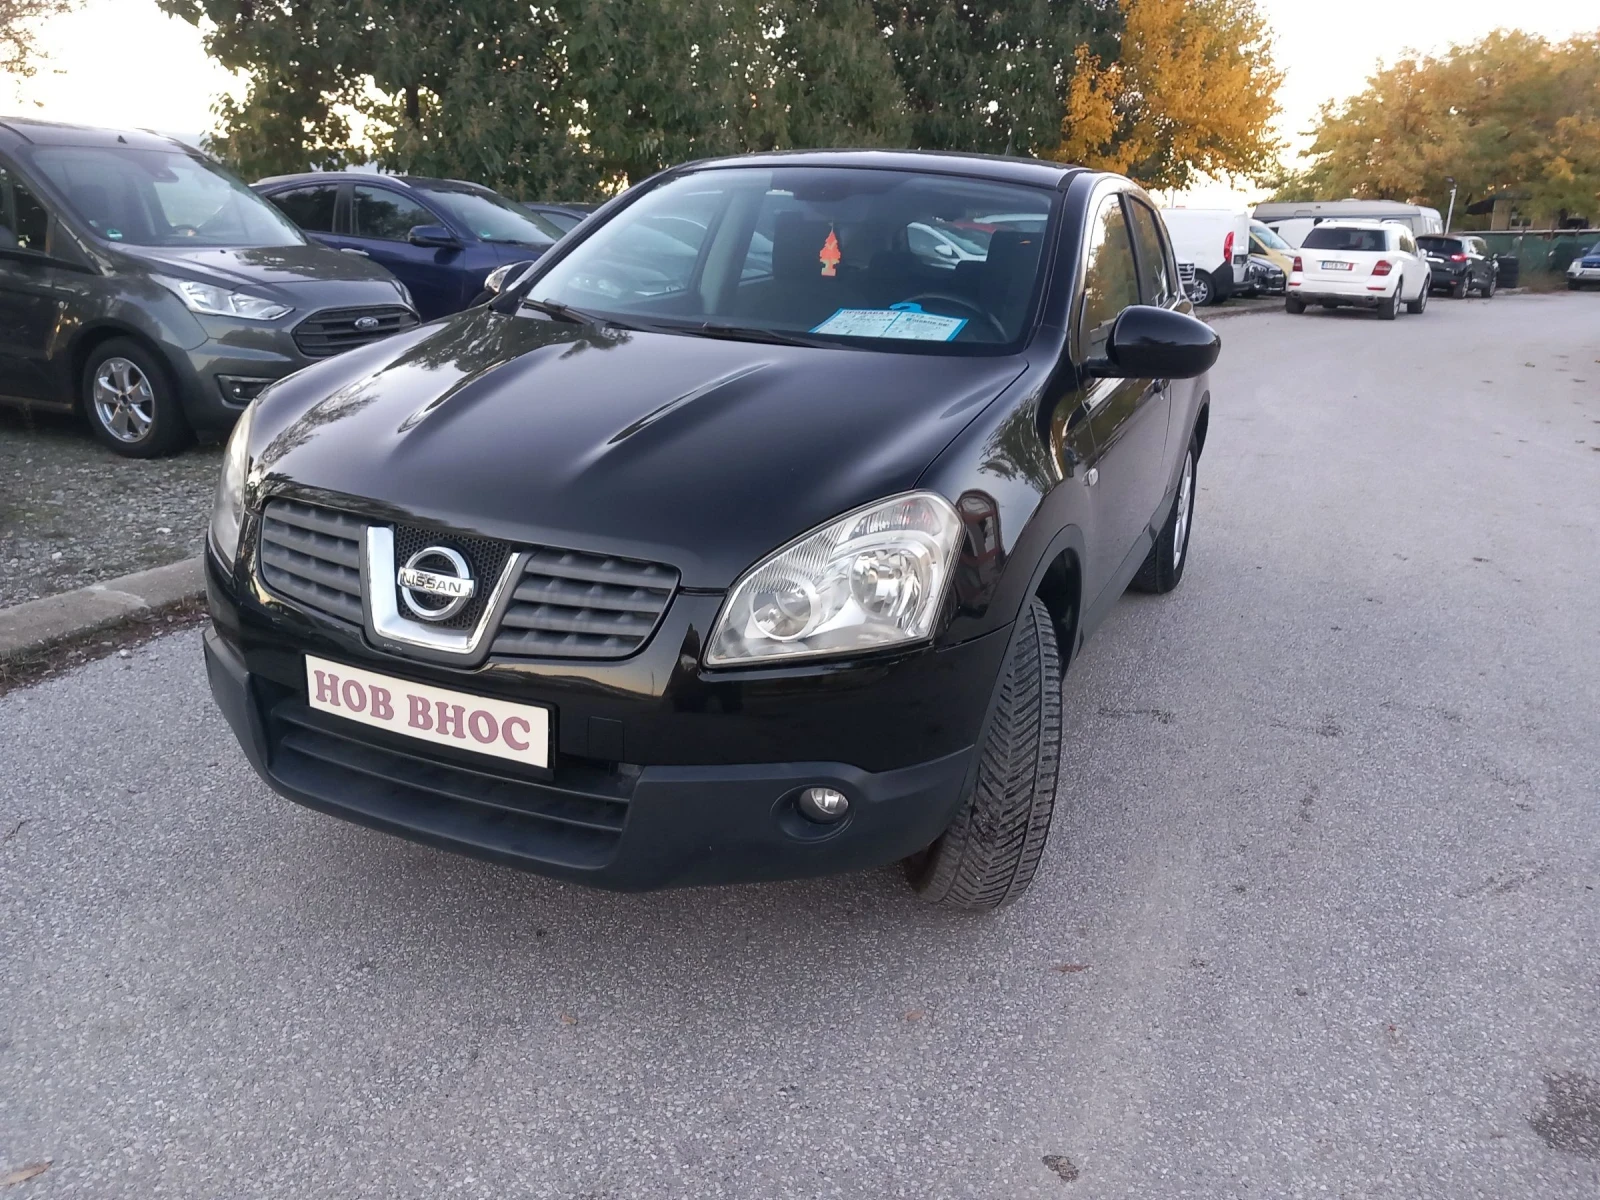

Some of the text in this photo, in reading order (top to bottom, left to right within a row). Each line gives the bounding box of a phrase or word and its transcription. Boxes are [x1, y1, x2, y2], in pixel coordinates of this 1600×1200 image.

[401, 570, 462, 593] NISSAN
[314, 669, 531, 751] НОВ ВНОС
